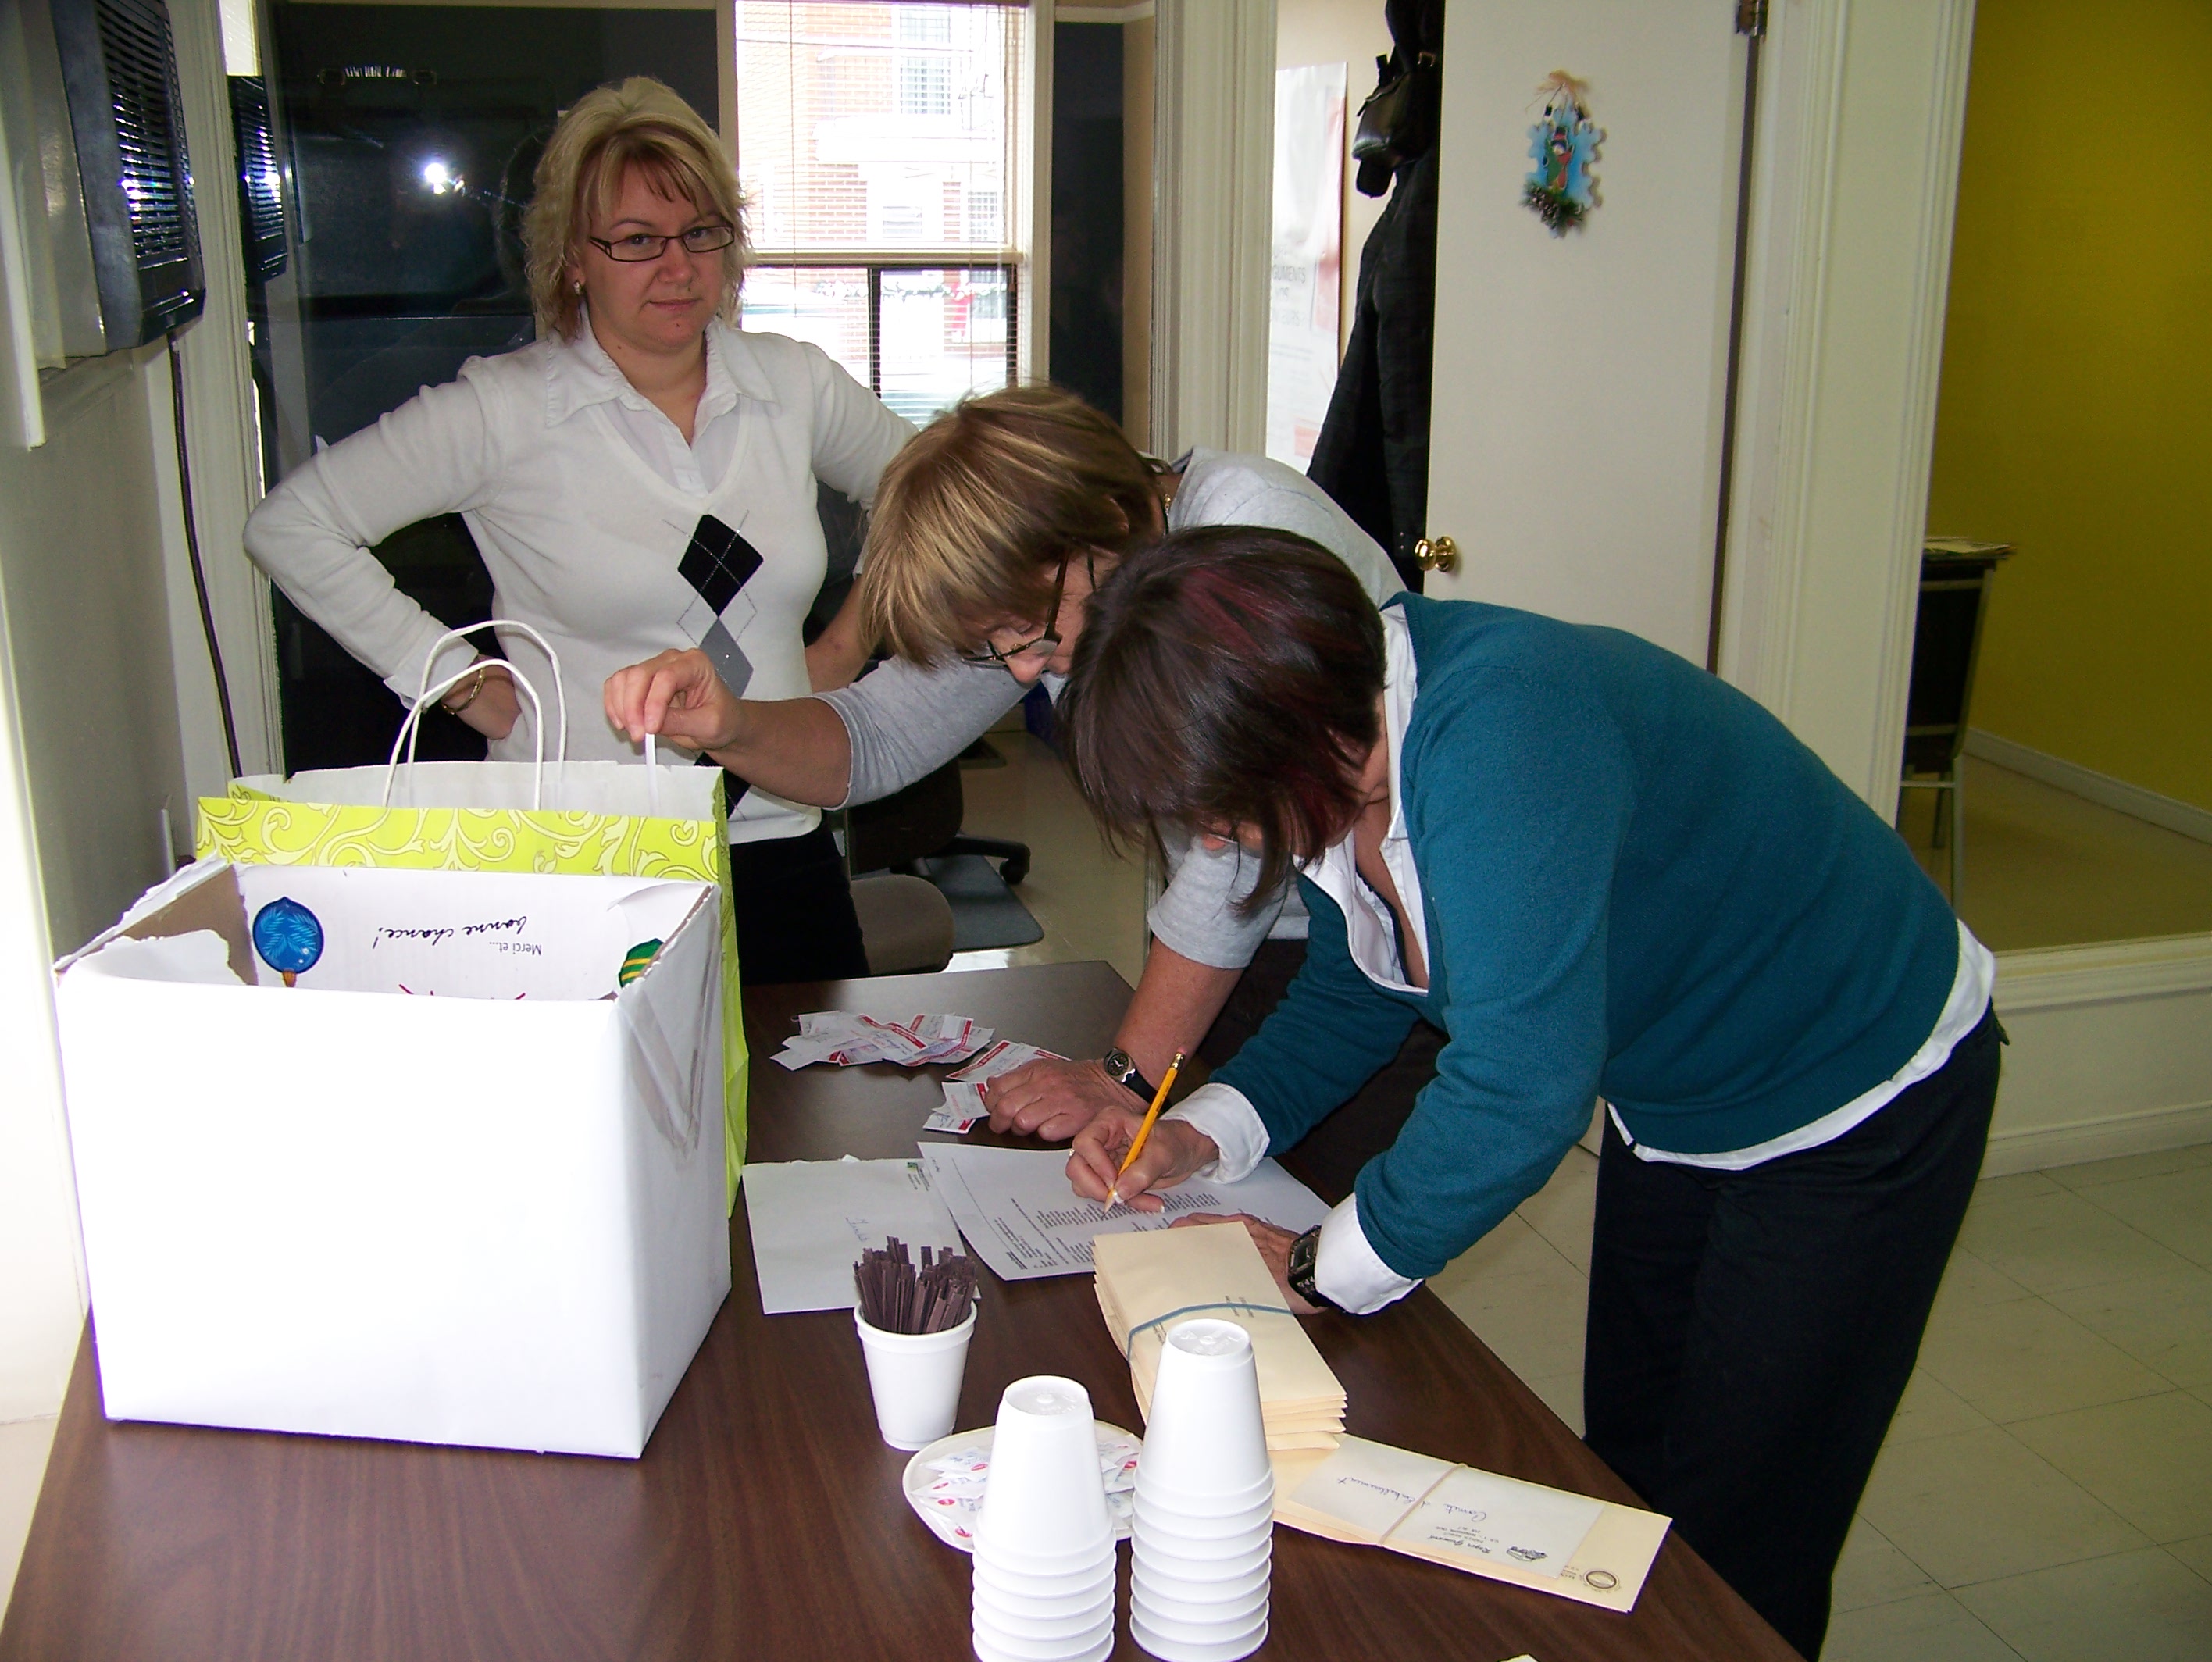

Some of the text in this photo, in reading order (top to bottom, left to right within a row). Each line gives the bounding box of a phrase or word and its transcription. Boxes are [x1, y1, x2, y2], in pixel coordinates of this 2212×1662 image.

[372, 915, 527, 950] bonne chance!
[512, 943, 542, 956] Merci
